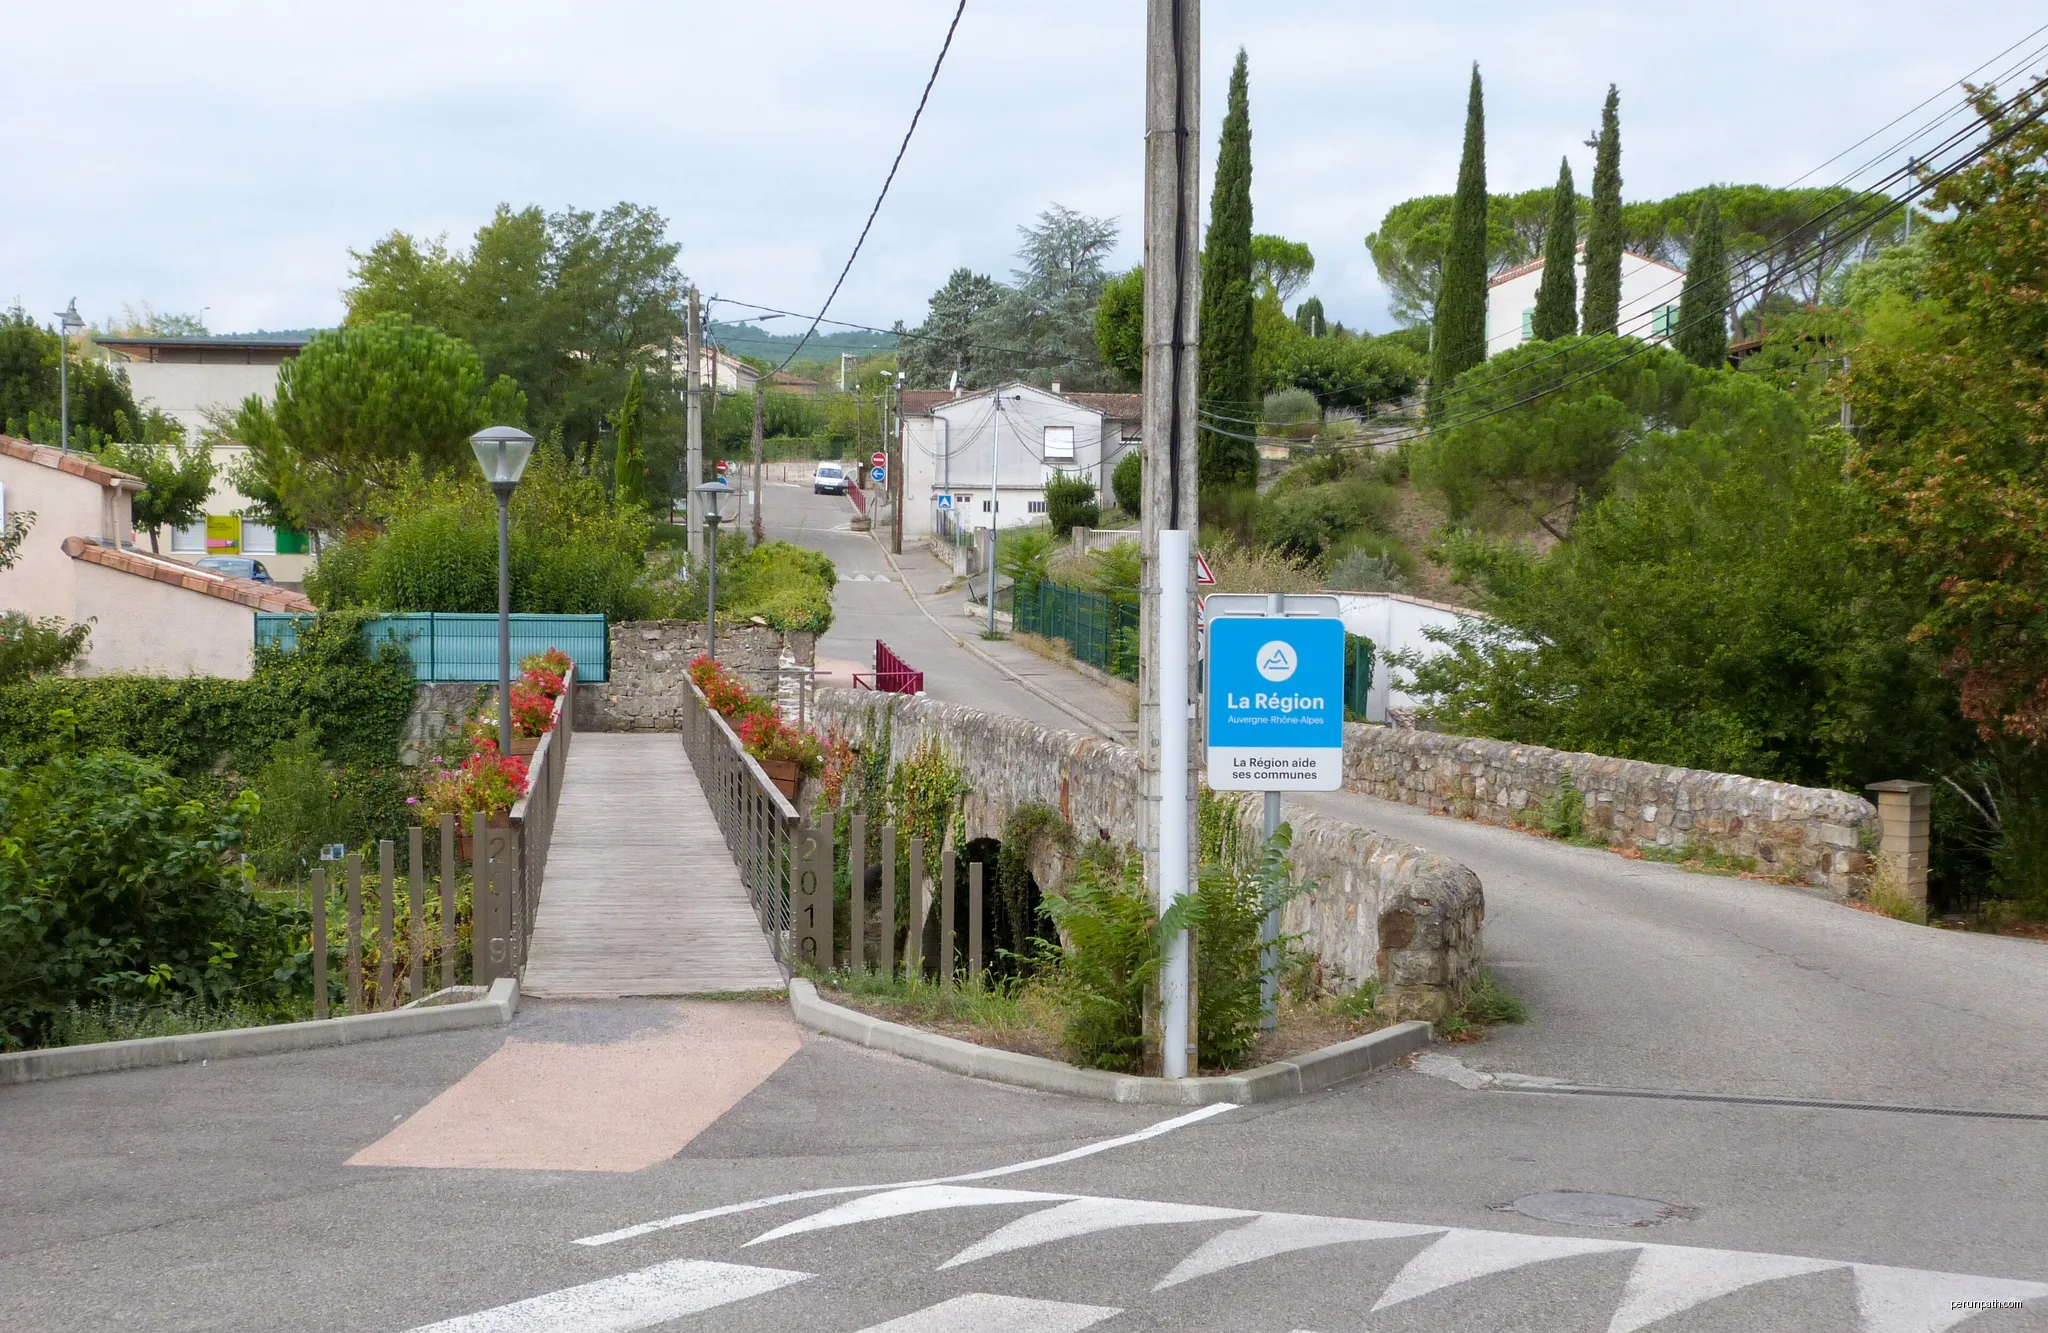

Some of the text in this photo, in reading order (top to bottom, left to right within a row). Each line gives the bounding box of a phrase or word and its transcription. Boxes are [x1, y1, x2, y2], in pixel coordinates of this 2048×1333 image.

[1227, 693, 1325, 712] La Région
[1228, 715, 1324, 725] Auvergne-Rhône-Alpes
[1233, 757, 1316, 770] La Région aide
[1232, 771, 1317, 780] ses communes
[489, 837, 506, 964] 209
[800, 837, 818, 959] 2019
